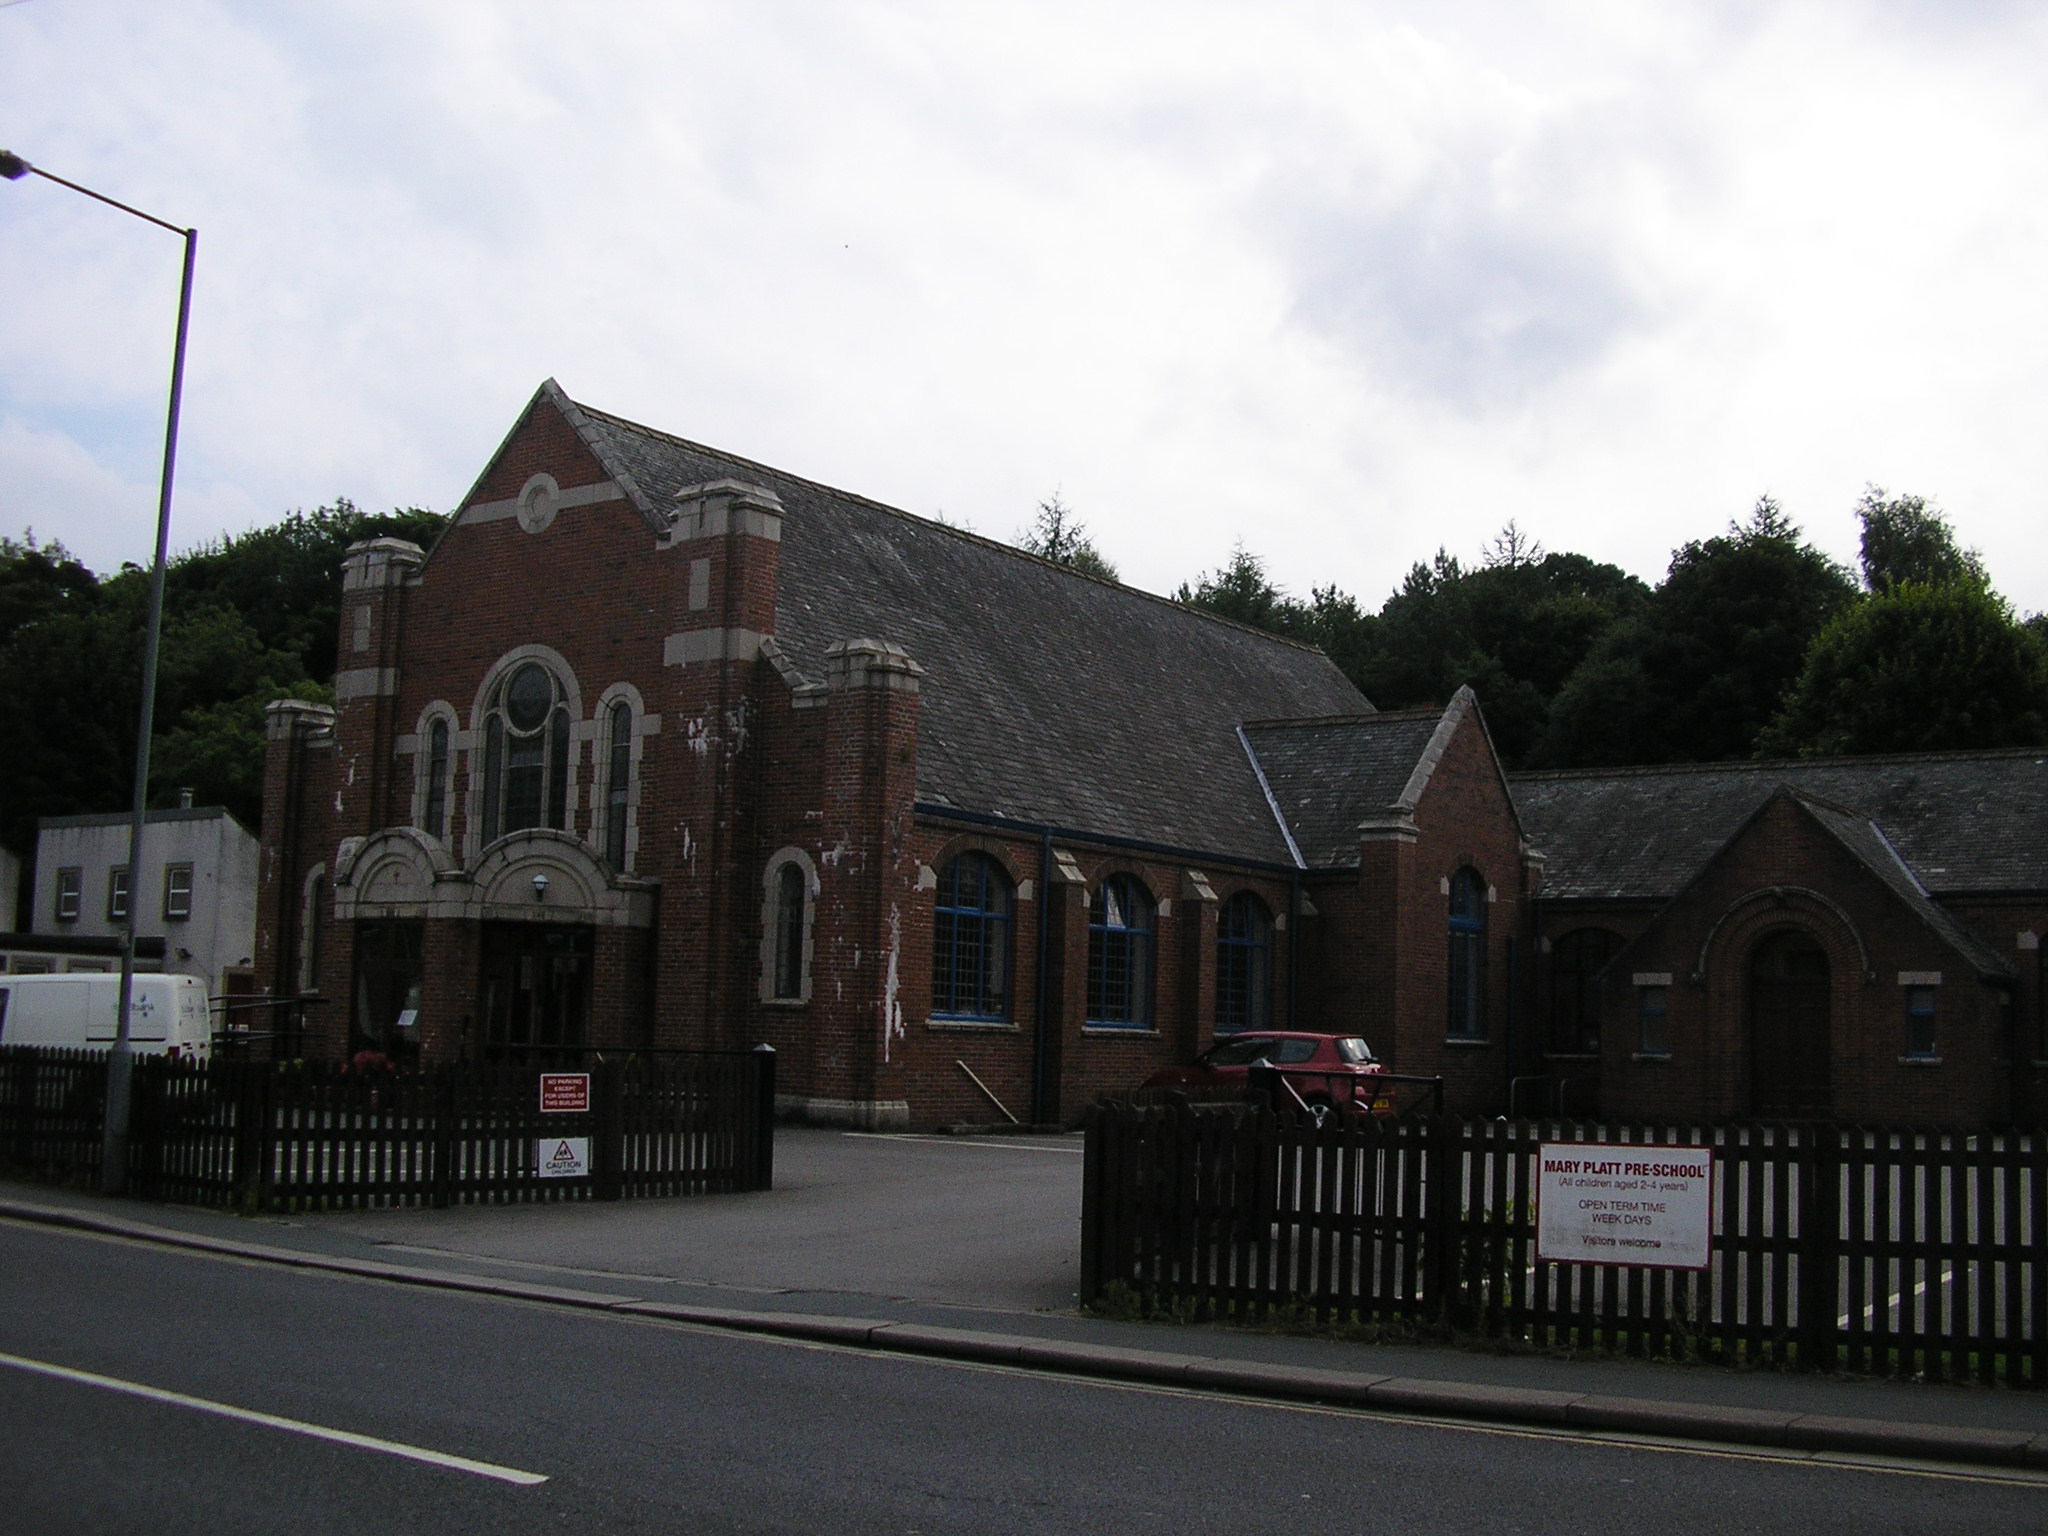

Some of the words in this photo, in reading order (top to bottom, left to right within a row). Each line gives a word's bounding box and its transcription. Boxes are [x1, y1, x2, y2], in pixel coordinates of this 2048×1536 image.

[546, 1161, 581, 1169] CAUTION
[1544, 1160, 1580, 1173] MARY
[1583, 1161, 1621, 1175] PLATT
[1625, 1163, 1704, 1178] PRE-SCHOOL
[1558, 1176, 1573, 1187] (All
[1575, 1177, 1612, 1189] children
[1614, 1179, 1638, 1191] aged
[1640, 1180, 1657, 1190] 2-4
[1659, 1181, 1688, 1192] years)
[1578, 1200, 1608, 1210] OPEN
[1610, 1201, 1639, 1211] TERM
[1641, 1202, 1666, 1213] TIME
[1592, 1213, 1621, 1224] WEEK
[1624, 1215, 1652, 1225] DAYS
[1582, 1235, 1617, 1247] Visitors
[1619, 1237, 1662, 1249] welcome
